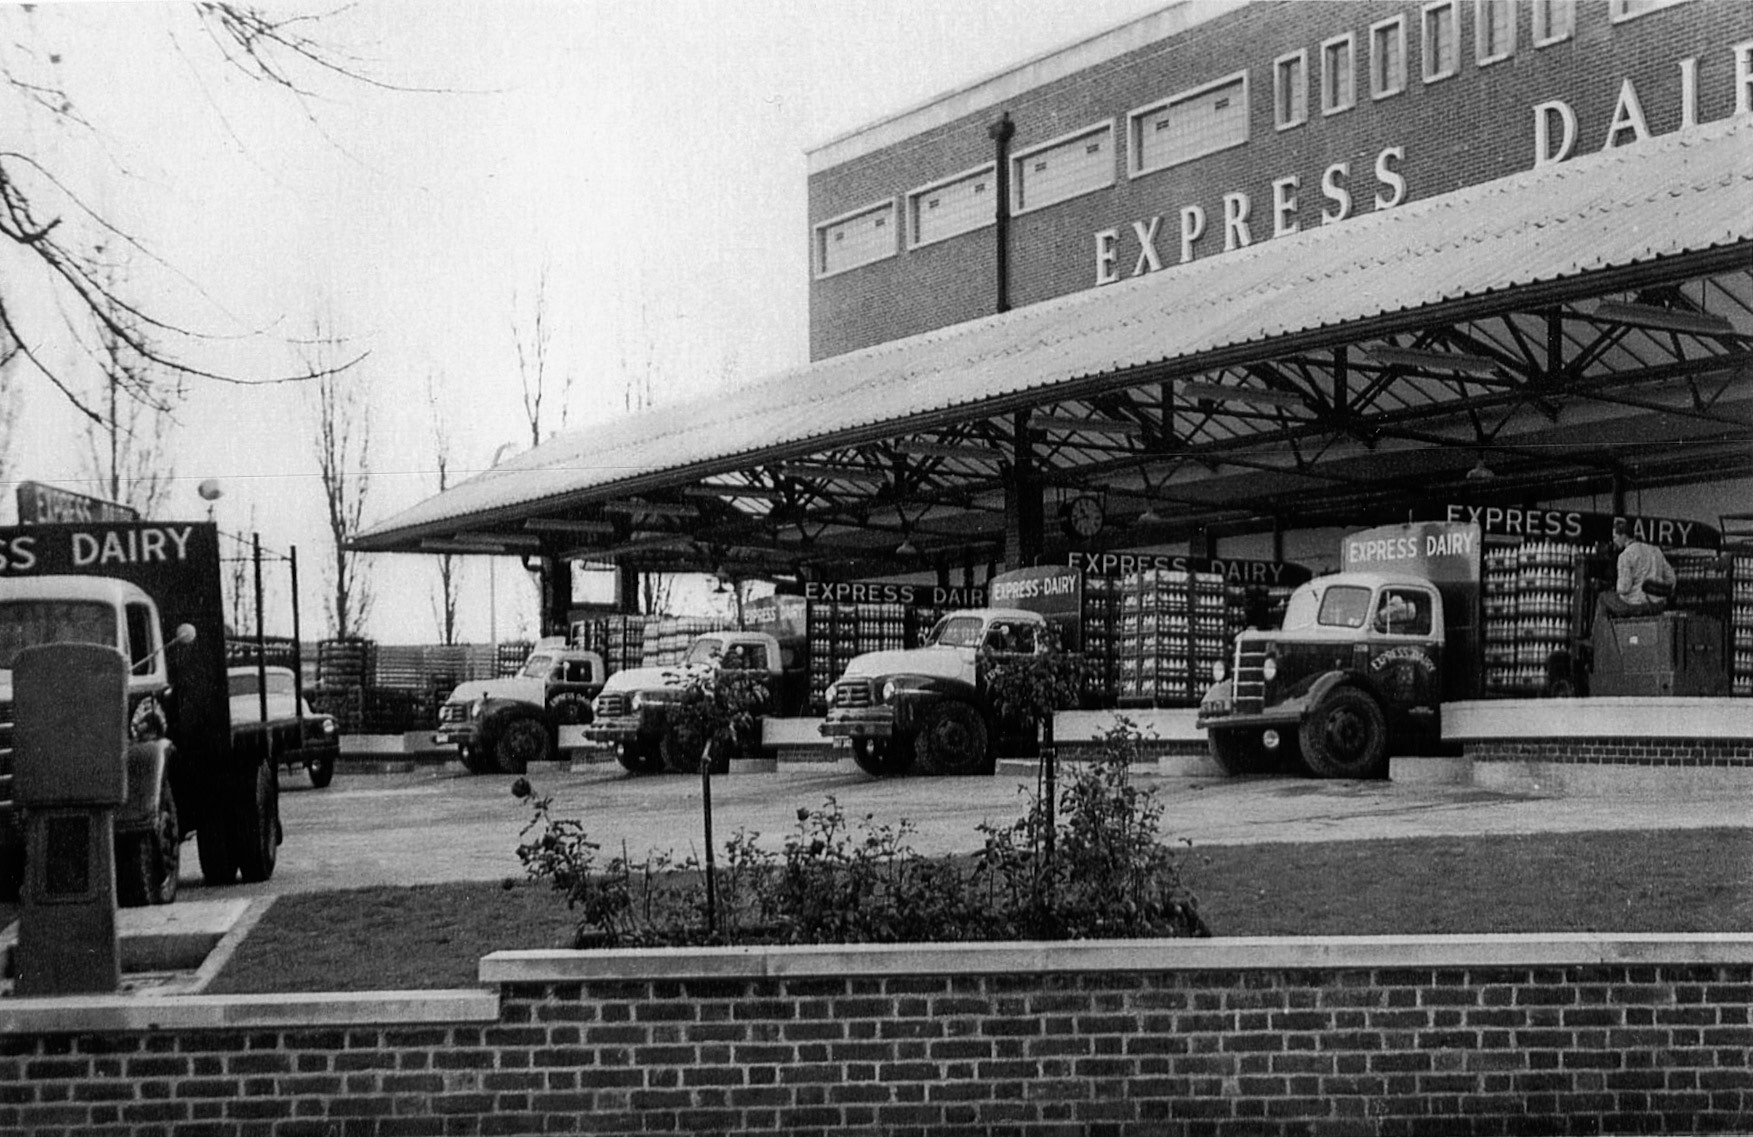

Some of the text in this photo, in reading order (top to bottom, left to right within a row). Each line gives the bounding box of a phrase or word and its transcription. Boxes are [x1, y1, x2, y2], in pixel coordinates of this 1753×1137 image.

[1094, 146, 1407, 287] EXPRESS
[1447, 504, 1582, 537] EXPRESS
[0, 526, 193, 570] S DAIRY
[1350, 532, 1474, 563] EXPRESS DAIRY
[1068, 552, 1283, 583] EXPRESS DAIRY
[805, 582, 914, 604] EXPRESS
